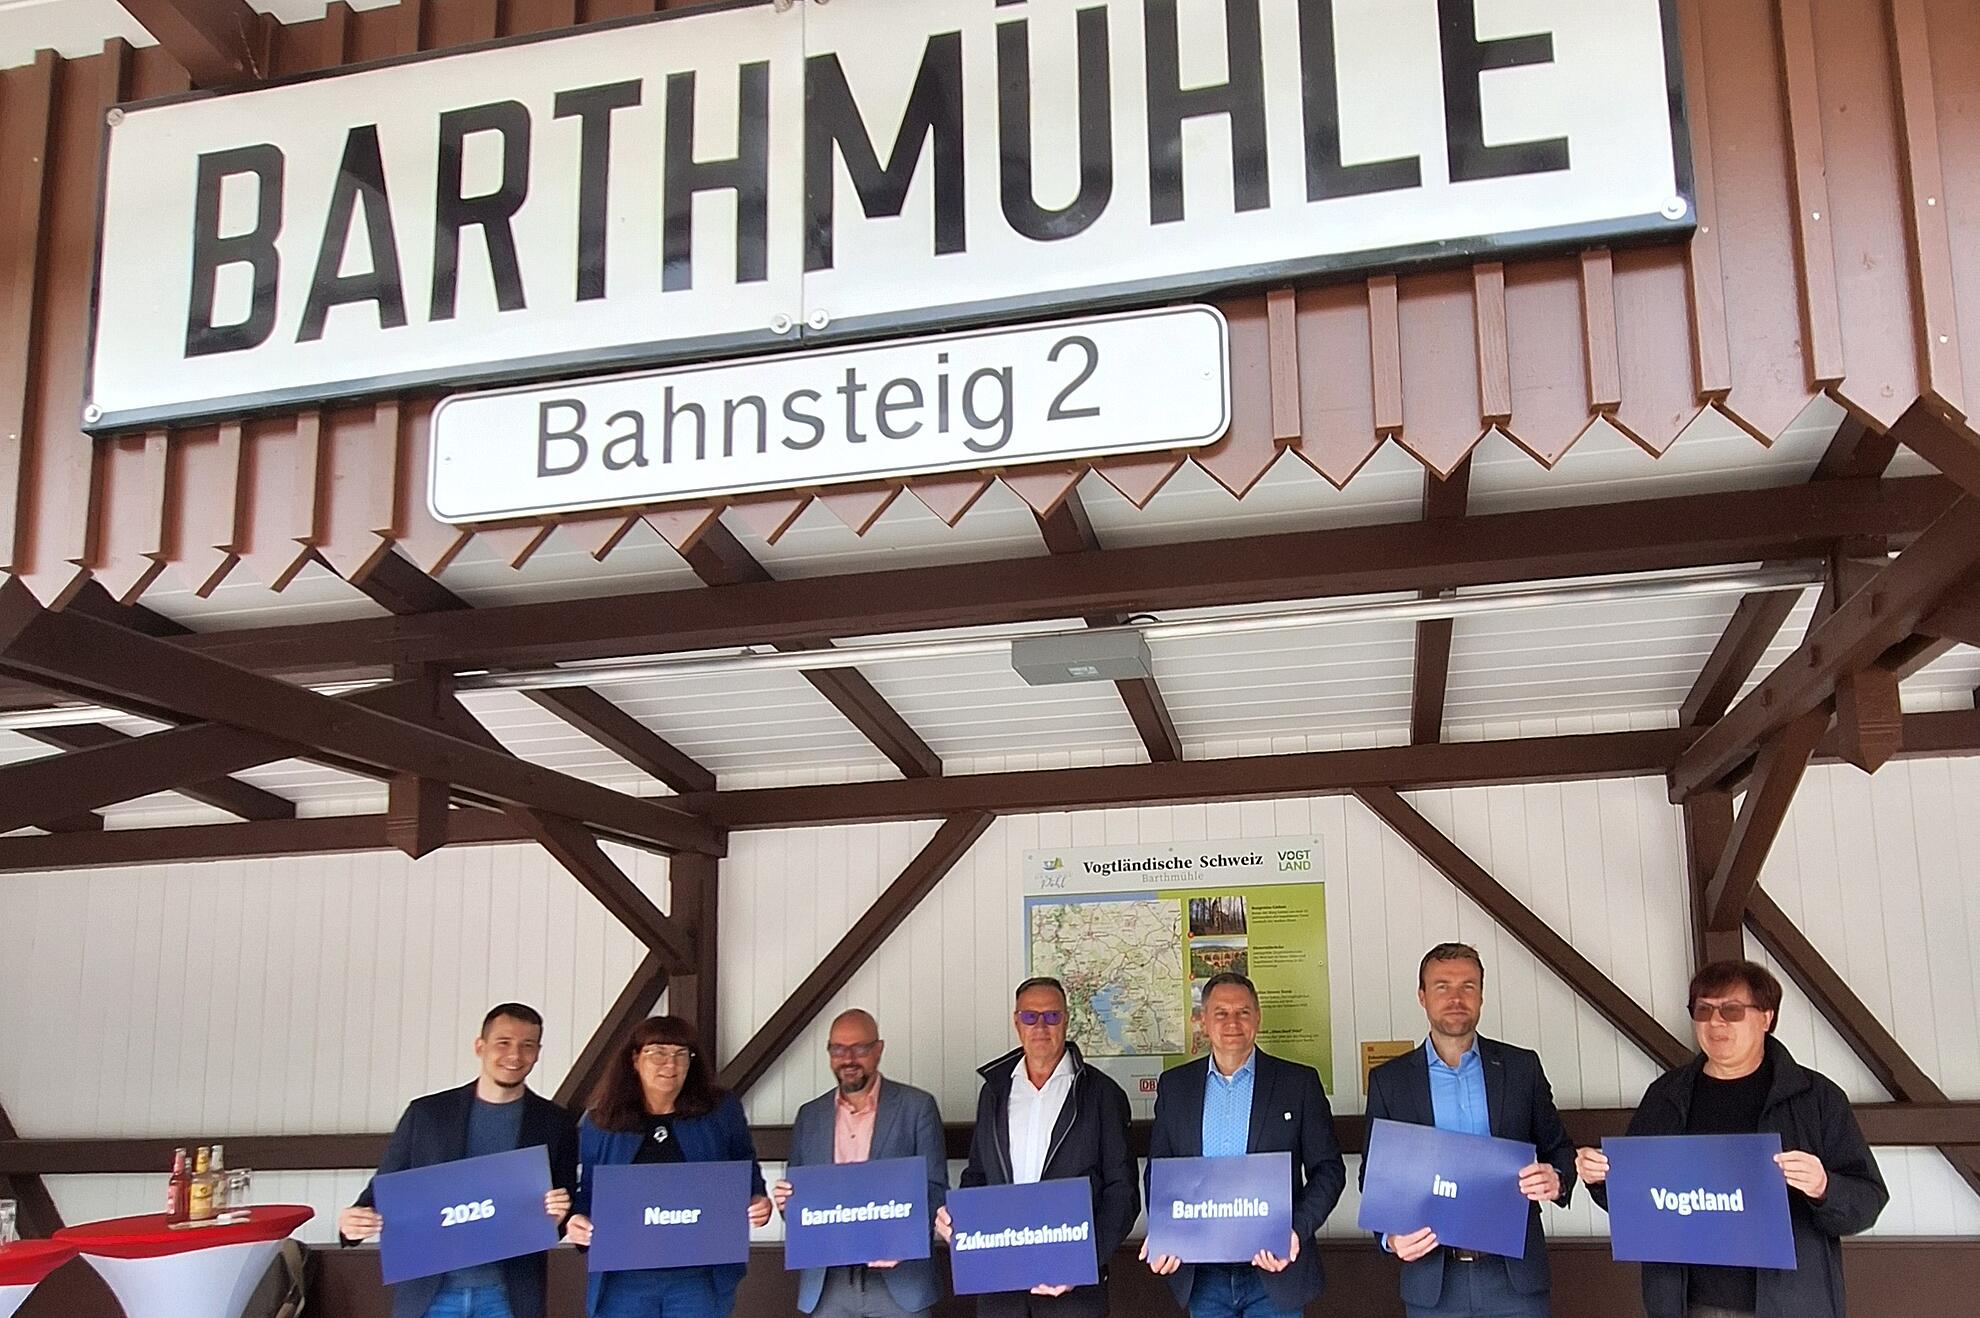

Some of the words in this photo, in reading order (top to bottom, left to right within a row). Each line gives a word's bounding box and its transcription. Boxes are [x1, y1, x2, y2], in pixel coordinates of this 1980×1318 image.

[186, 0, 1570, 358] BARTHMÜHLE
[536, 353, 1014, 478] Bahnsteig
[1047, 335, 1101, 421] 2
[1083, 856, 1193, 876] Vogtländische
[1199, 852, 1264, 869] Schweiz
[1278, 850, 1311, 861] VOGT
[1279, 861, 1311, 871] LAND
[1142, 871, 1204, 883] Barthmühle
[1142, 1079, 1156, 1090] DB
[1433, 1174, 1458, 1198] im
[440, 1199, 496, 1227] 2026
[801, 1199, 913, 1226] barrierefreier
[1172, 1197, 1269, 1219] Barthmühle
[1650, 1187, 1745, 1216] Vogtland
[644, 1207, 701, 1225] Neuer
[955, 1221, 1090, 1251] Zukunftsbahnhof
